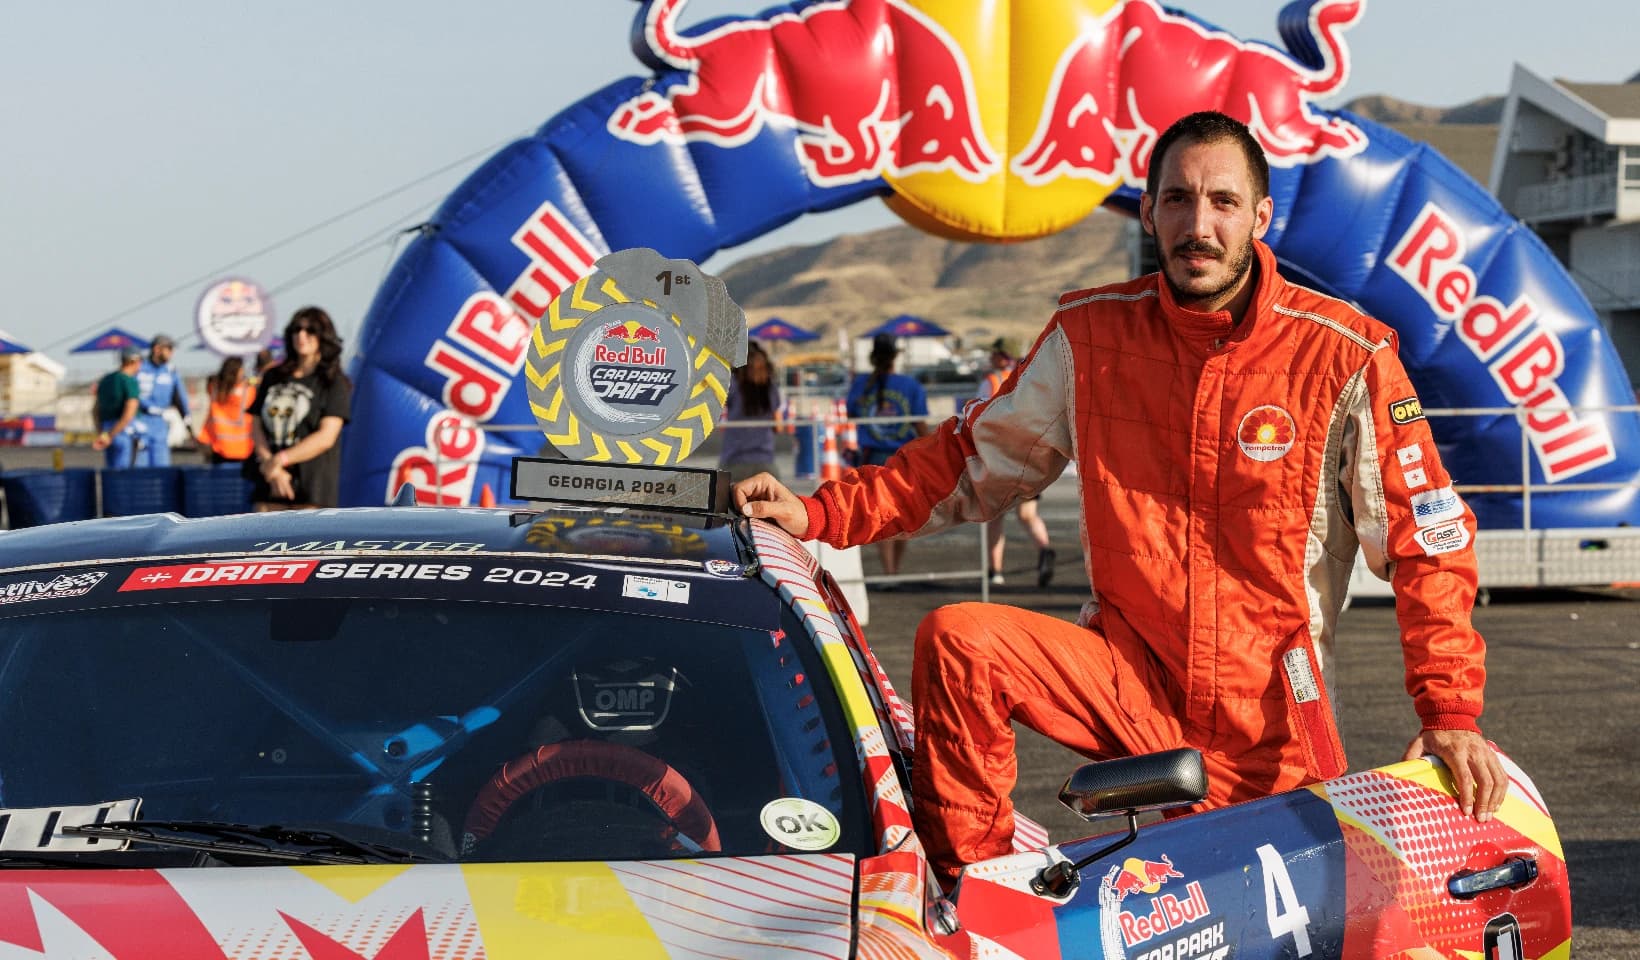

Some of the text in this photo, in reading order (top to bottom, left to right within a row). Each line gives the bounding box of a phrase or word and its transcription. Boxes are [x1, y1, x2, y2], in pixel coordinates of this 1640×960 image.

[655, 270, 691, 296] 1st
[387, 343, 509, 506] Red
[450, 203, 598, 373] Bull
[595, 344, 667, 366] Red Bull
[1388, 204, 1614, 481] Red Bull
[592, 368, 672, 383] CAR PARK
[594, 380, 671, 401] DRIFT
[548, 475, 677, 495] GEORGIA 2024
[180, 563, 598, 590] DRIFT SERIES 2024
[595, 688, 655, 711] OMP
[775, 813, 830, 833] OK
[1119, 881, 1209, 946] Red Bull
[1256, 843, 1312, 958] 4
[1176, 922, 1224, 960] PARK
